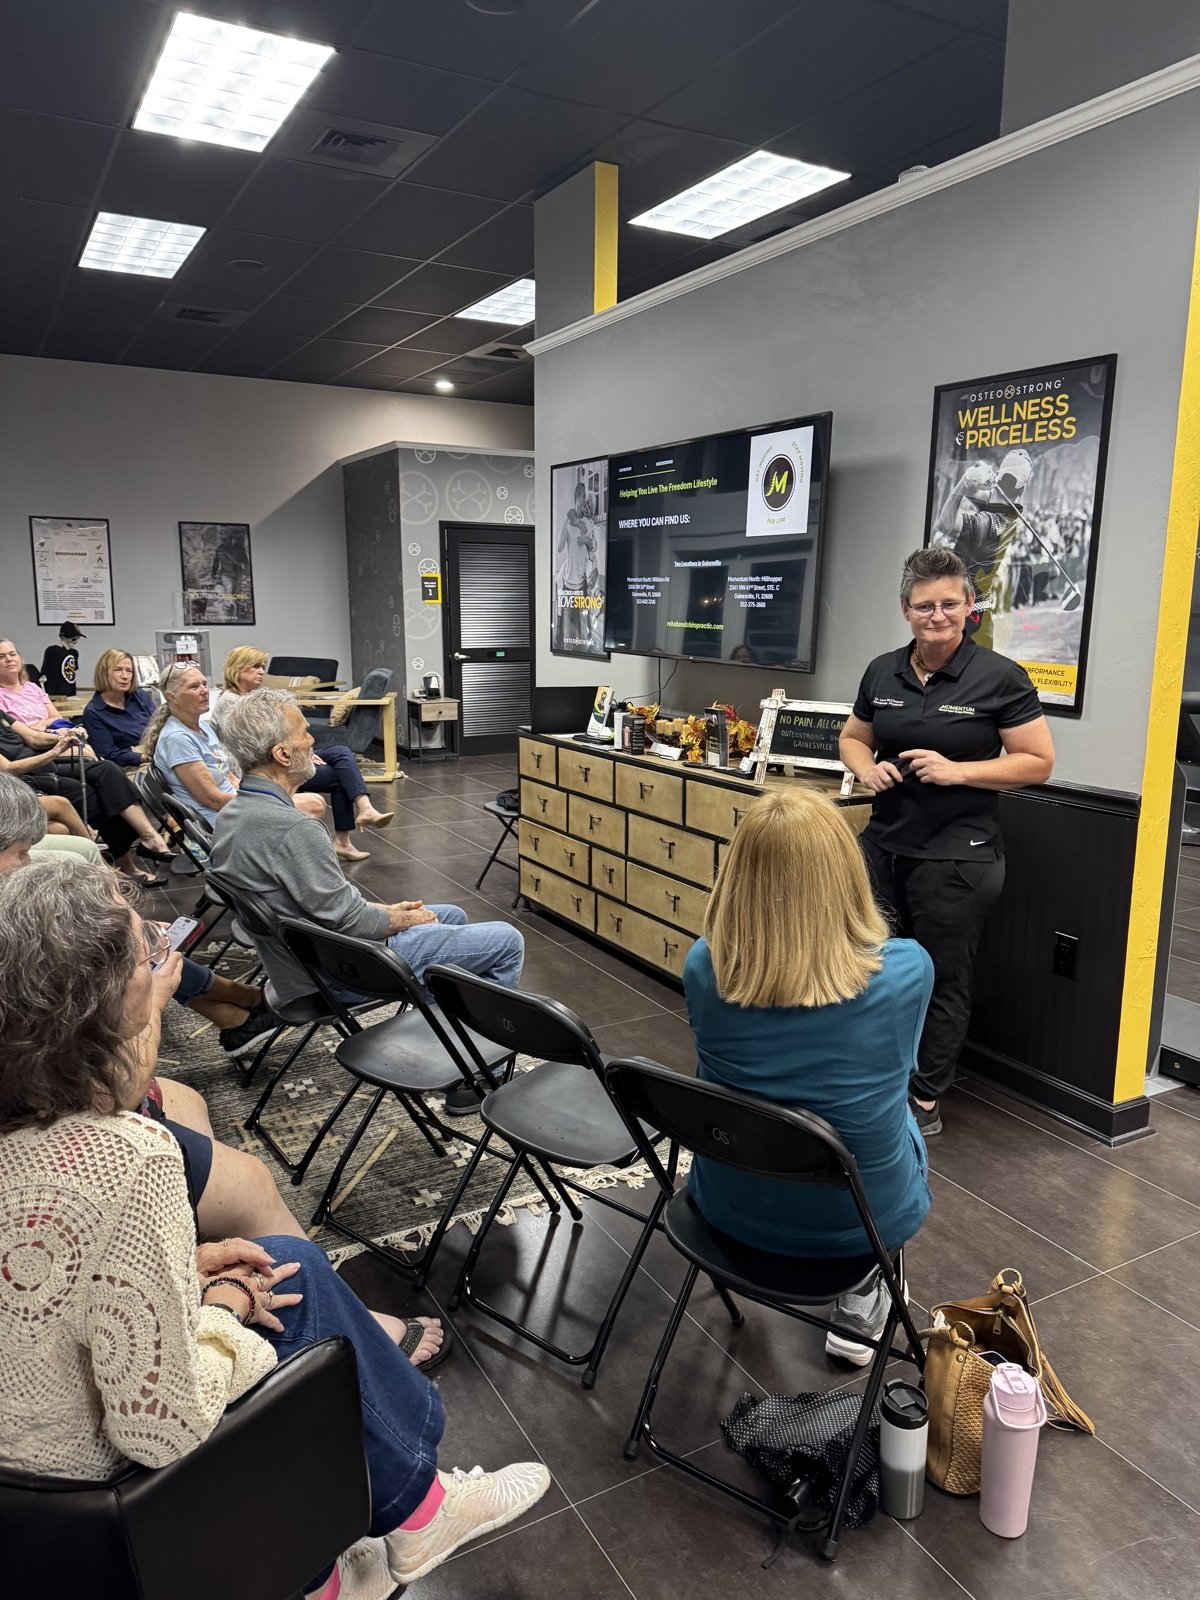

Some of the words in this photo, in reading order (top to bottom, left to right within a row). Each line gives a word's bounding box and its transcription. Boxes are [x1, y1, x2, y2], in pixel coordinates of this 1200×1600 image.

[970, 390, 1003, 402] OSTEO
[1016, 380, 1062, 395] STRONG
[958, 394, 1070, 429] WELLNESS
[966, 416, 1076, 450] PRICELESS
[620, 488, 638, 498] Helping
[648, 486, 658, 494] Live
[659, 484, 668, 492] The
[669, 482, 692, 491] Freedom
[694, 477, 718, 488] Lifestyle
[619, 519, 638, 528] WHERE
[639, 518, 650, 527] YOU
[652, 516, 664, 526] CAN
[665, 515, 679, 525] FIND
[680, 514, 690, 523] US:
[1025, 667, 1065, 676] RFORMANCE
[1038, 678, 1073, 687] FLEXIBILITY
[780, 715, 791, 725] NO
[794, 716, 815, 728] PAIN.
[817, 718, 829, 729] ALL
[781, 730, 825, 740] OSTEOSTRONG
[793, 740, 833, 750] GAINESVILLE
[712, 1128, 730, 1144] OS
